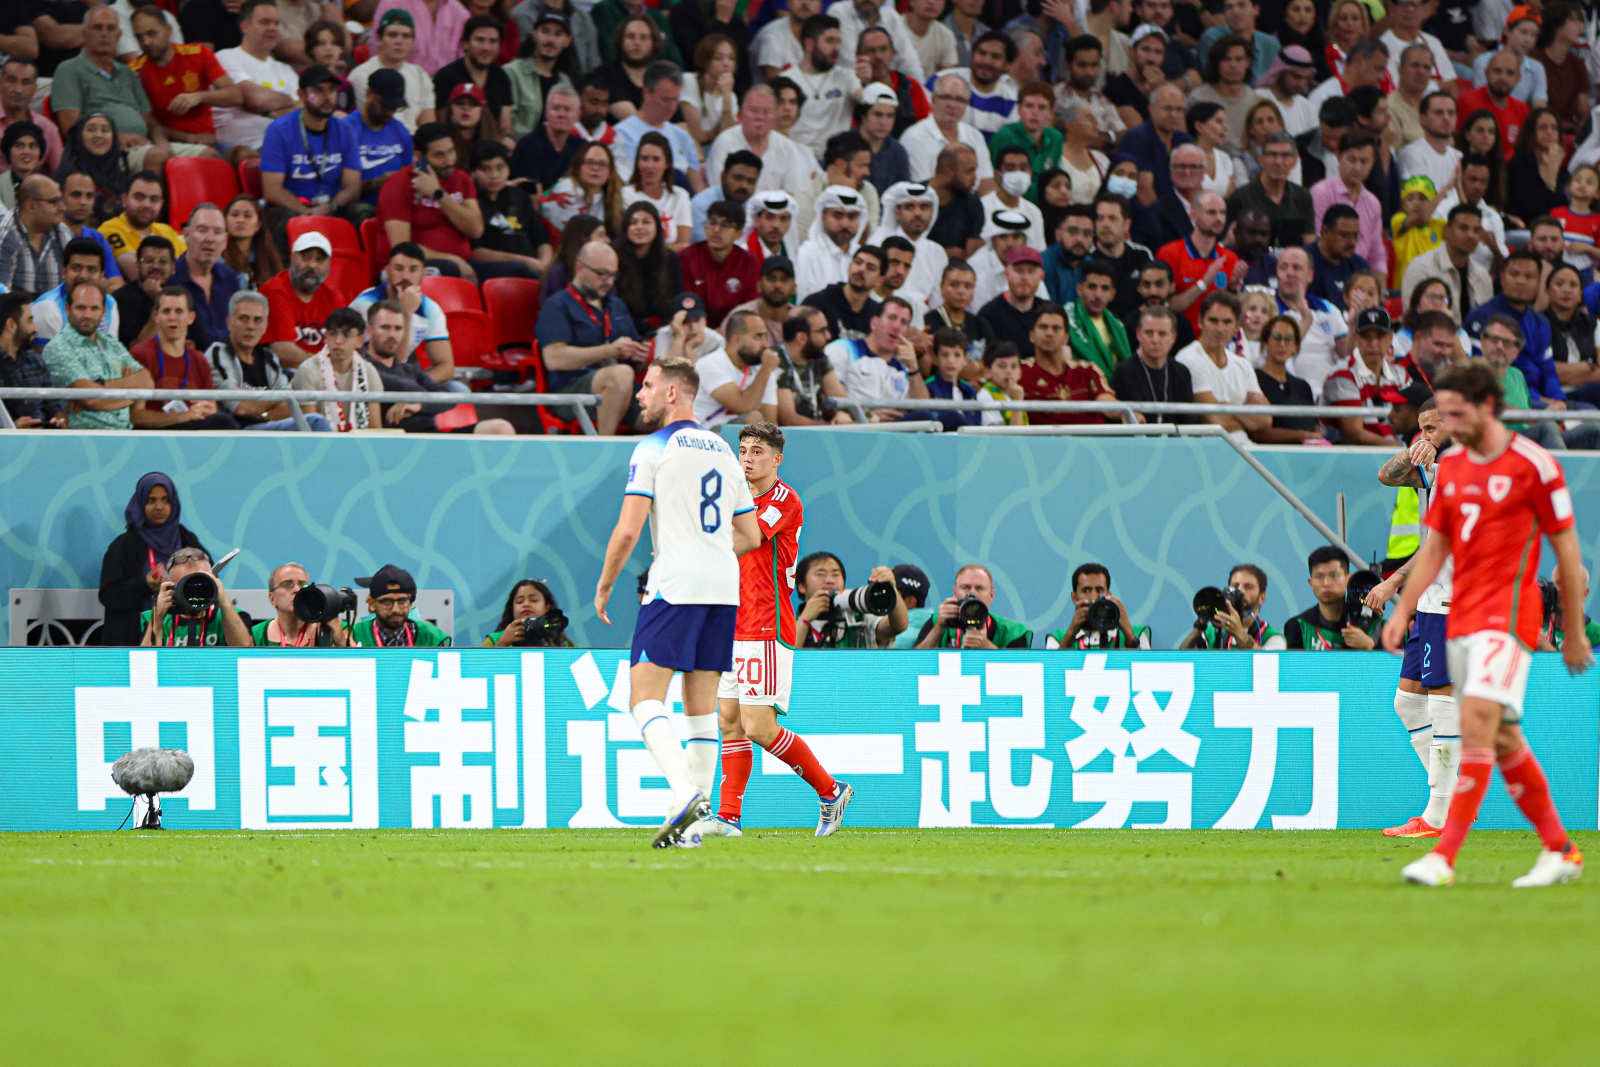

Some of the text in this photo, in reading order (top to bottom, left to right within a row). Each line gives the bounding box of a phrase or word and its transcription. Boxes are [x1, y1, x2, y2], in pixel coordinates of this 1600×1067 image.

[676, 435, 732, 457] HENDERS
[700, 468, 722, 534] 8
[1460, 502, 1481, 542] 7
[1422, 642, 1431, 668] 2
[1483, 638, 1505, 667] 7
[735, 657, 762, 684] 20
[762, 653, 1339, 830] 一起努力
